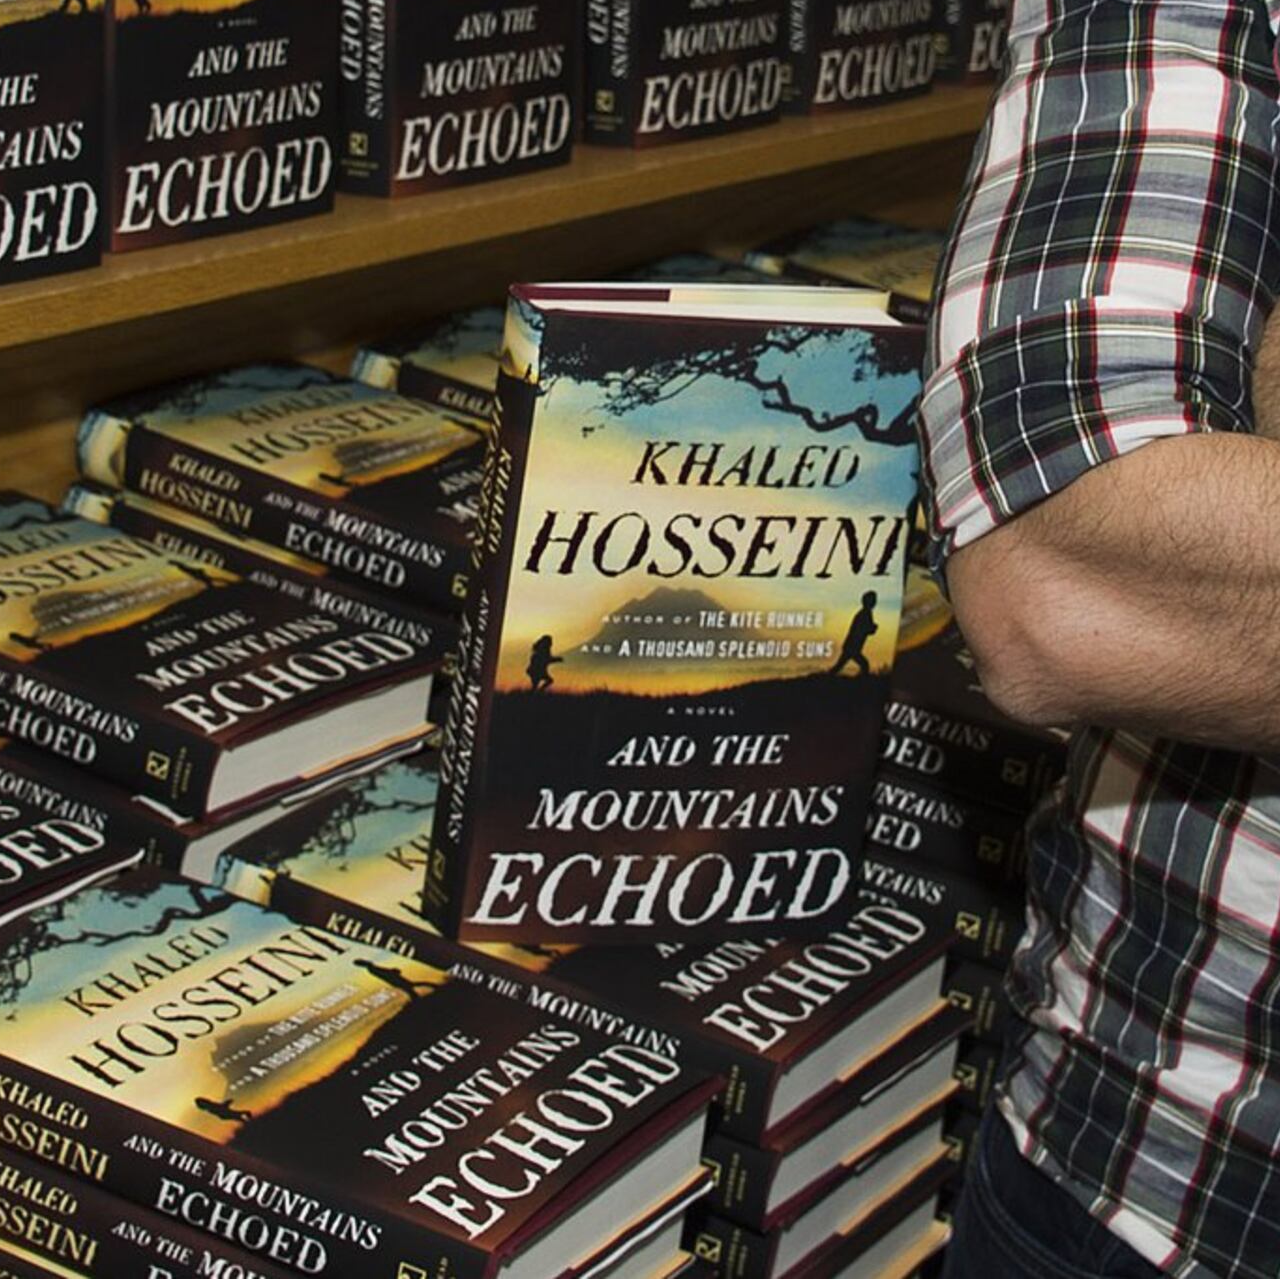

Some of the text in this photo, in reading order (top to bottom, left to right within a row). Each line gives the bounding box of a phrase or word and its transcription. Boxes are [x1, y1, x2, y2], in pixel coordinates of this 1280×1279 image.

[501, 5, 539, 33] THE
[188, 38, 289, 78] AND THE
[420, 46, 564, 100] MOUNTAINS
[814, 30, 936, 105] ECHOED
[147, 80, 323, 143] MOUNTAINS
[637, 56, 784, 134] ECHOED
[396, 93, 570, 182] ECHOED
[116, 134, 333, 234] ECHOED
[138, 468, 254, 531] HOSSEINI
[630, 440, 861, 490] KHALED
[284, 522, 407, 590] ECHOED
[326, 507, 447, 569] MOUNTAINS
[523, 510, 905, 580] HOSSEINI
[618, 639, 631, 658] A
[637, 639, 715, 659] THOUSAND
[718, 640, 792, 659] SPLENDID
[796, 641, 834, 658] SUNS
[698, 610, 729, 629] THE
[729, 610, 764, 629] KITE
[766, 610, 824, 629] RUNNER
[14, 671, 140, 744] MOUNTAINS
[163, 629, 416, 736] ECHOED
[684, 705, 736, 717] NOVEL
[607, 733, 790, 768] AND THE
[527, 784, 845, 833] MOUNTAINS
[463, 845, 852, 928] ECHOED
[63, 924, 230, 1018] KHALED
[449, 962, 523, 1000] AND THE
[703, 905, 927, 1054] ECHOED
[67, 924, 352, 1089] HOSSEINI
[360, 1029, 482, 1119] AND THE
[363, 1023, 581, 1177] MOUNTAINS
[409, 1043, 682, 1240] ECHOED
[111, 1220, 152, 1247] AND
[156, 1177, 328, 1277] ECHOED
[167, 1147, 383, 1251] THE MOUNTAINS
